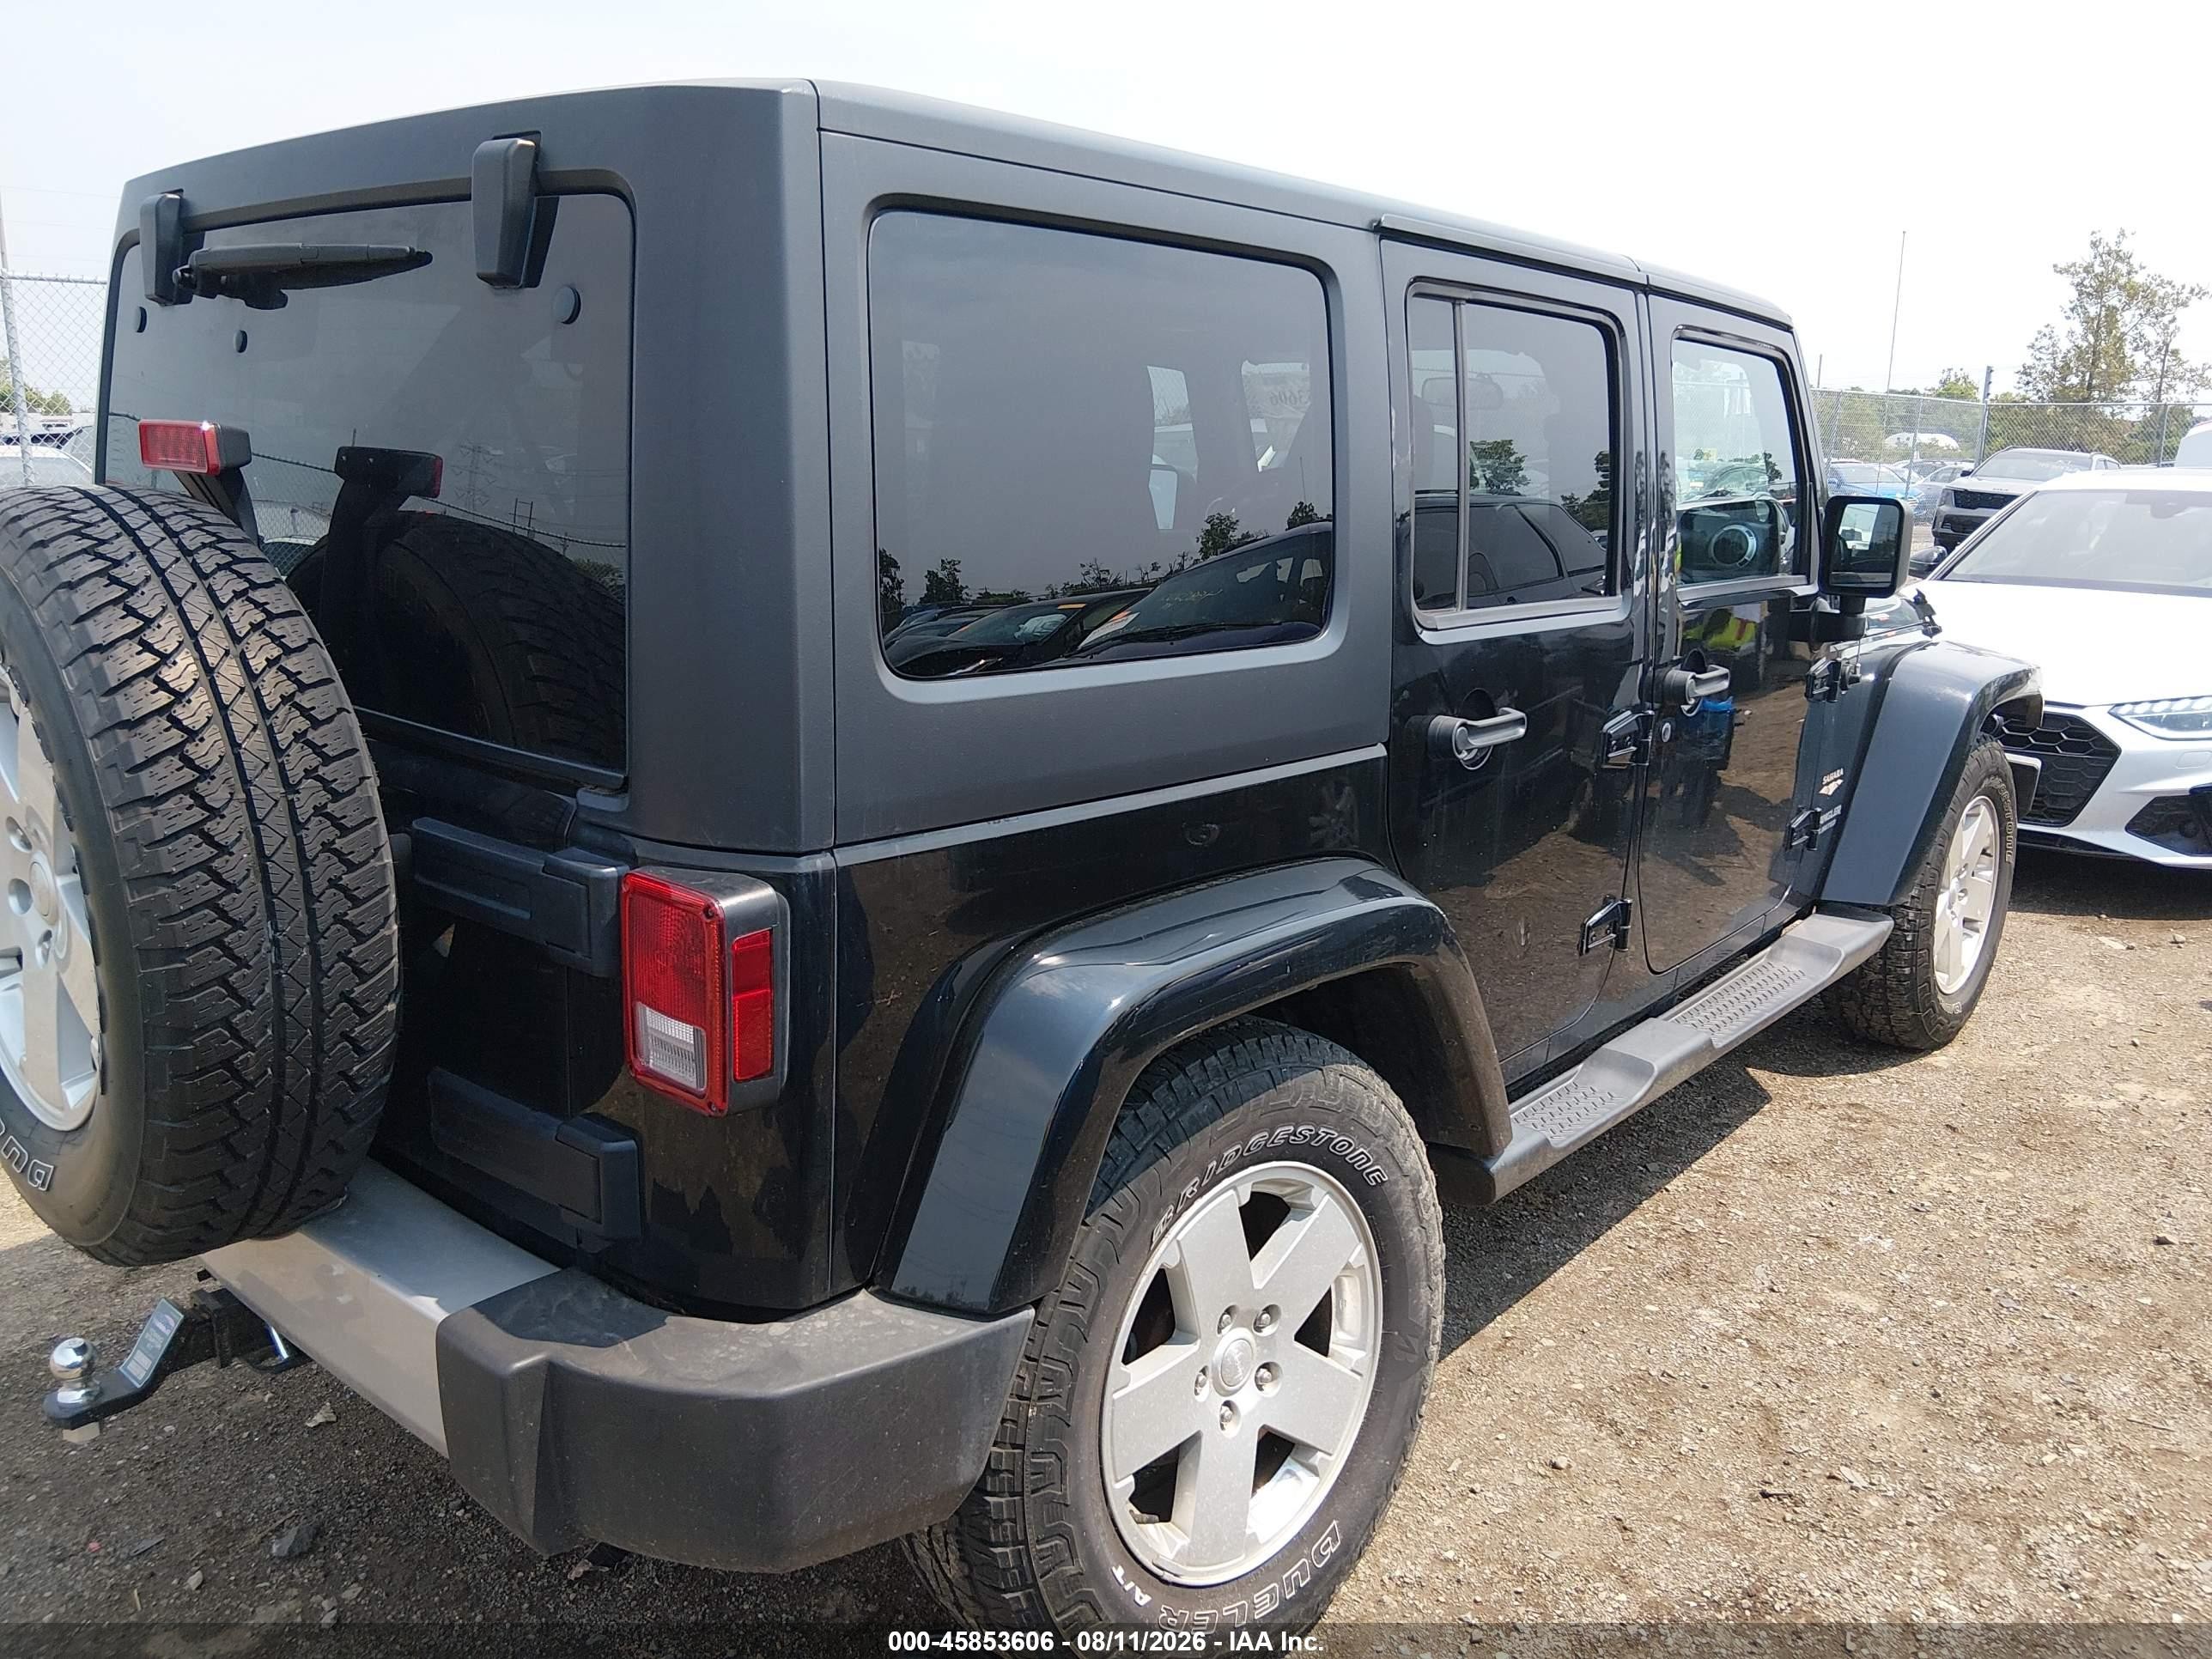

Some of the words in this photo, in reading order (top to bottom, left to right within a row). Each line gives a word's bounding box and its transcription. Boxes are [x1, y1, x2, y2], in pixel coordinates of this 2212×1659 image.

[0, 1117, 55, 1192] DU
[1151, 1126, 1389, 1251] BRIDGESTONE
[1111, 1565, 1152, 1606] A/T
[1159, 1520, 1341, 1634] DUELER
